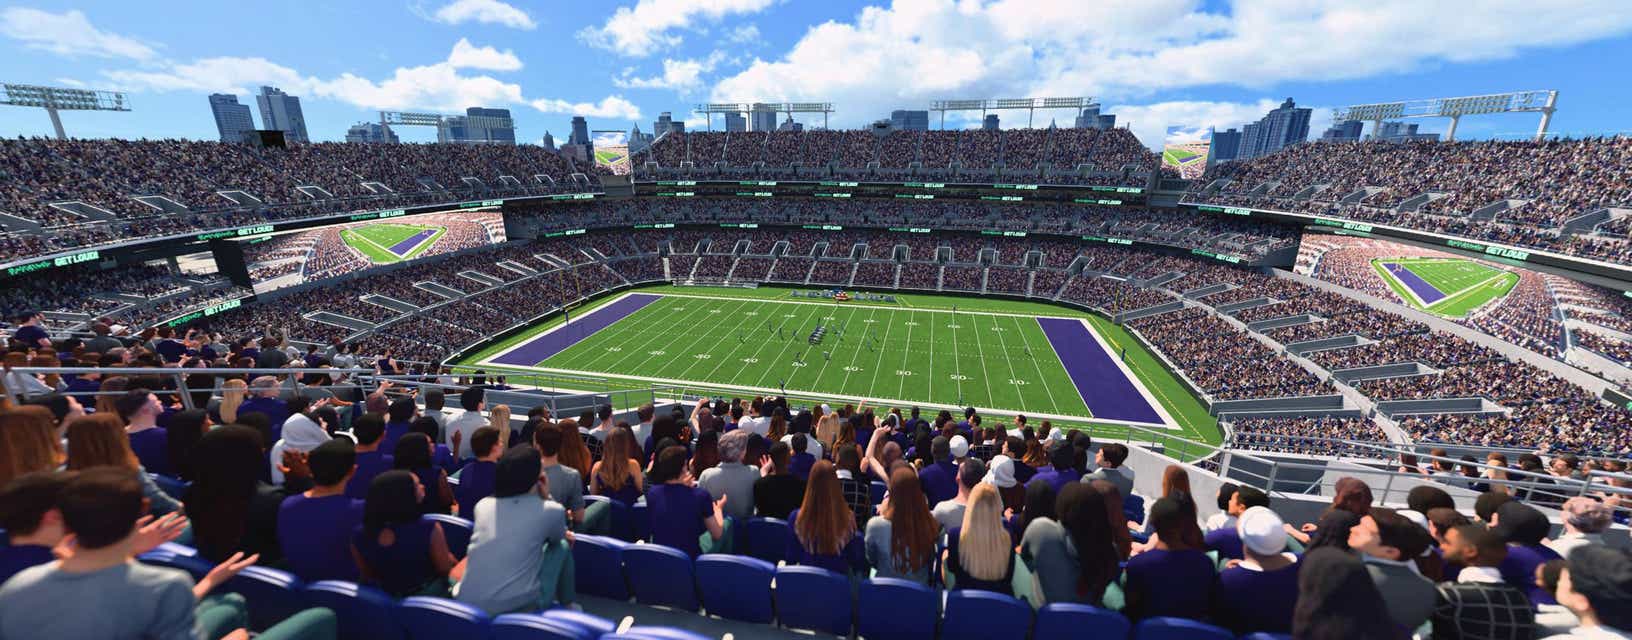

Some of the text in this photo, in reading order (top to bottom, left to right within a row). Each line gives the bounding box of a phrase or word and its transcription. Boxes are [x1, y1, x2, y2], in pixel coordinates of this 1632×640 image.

[238, 228, 252, 236] GET
[1486, 246, 1502, 255] GET
[55, 256, 72, 266] GET
[204, 306, 219, 316] GET
